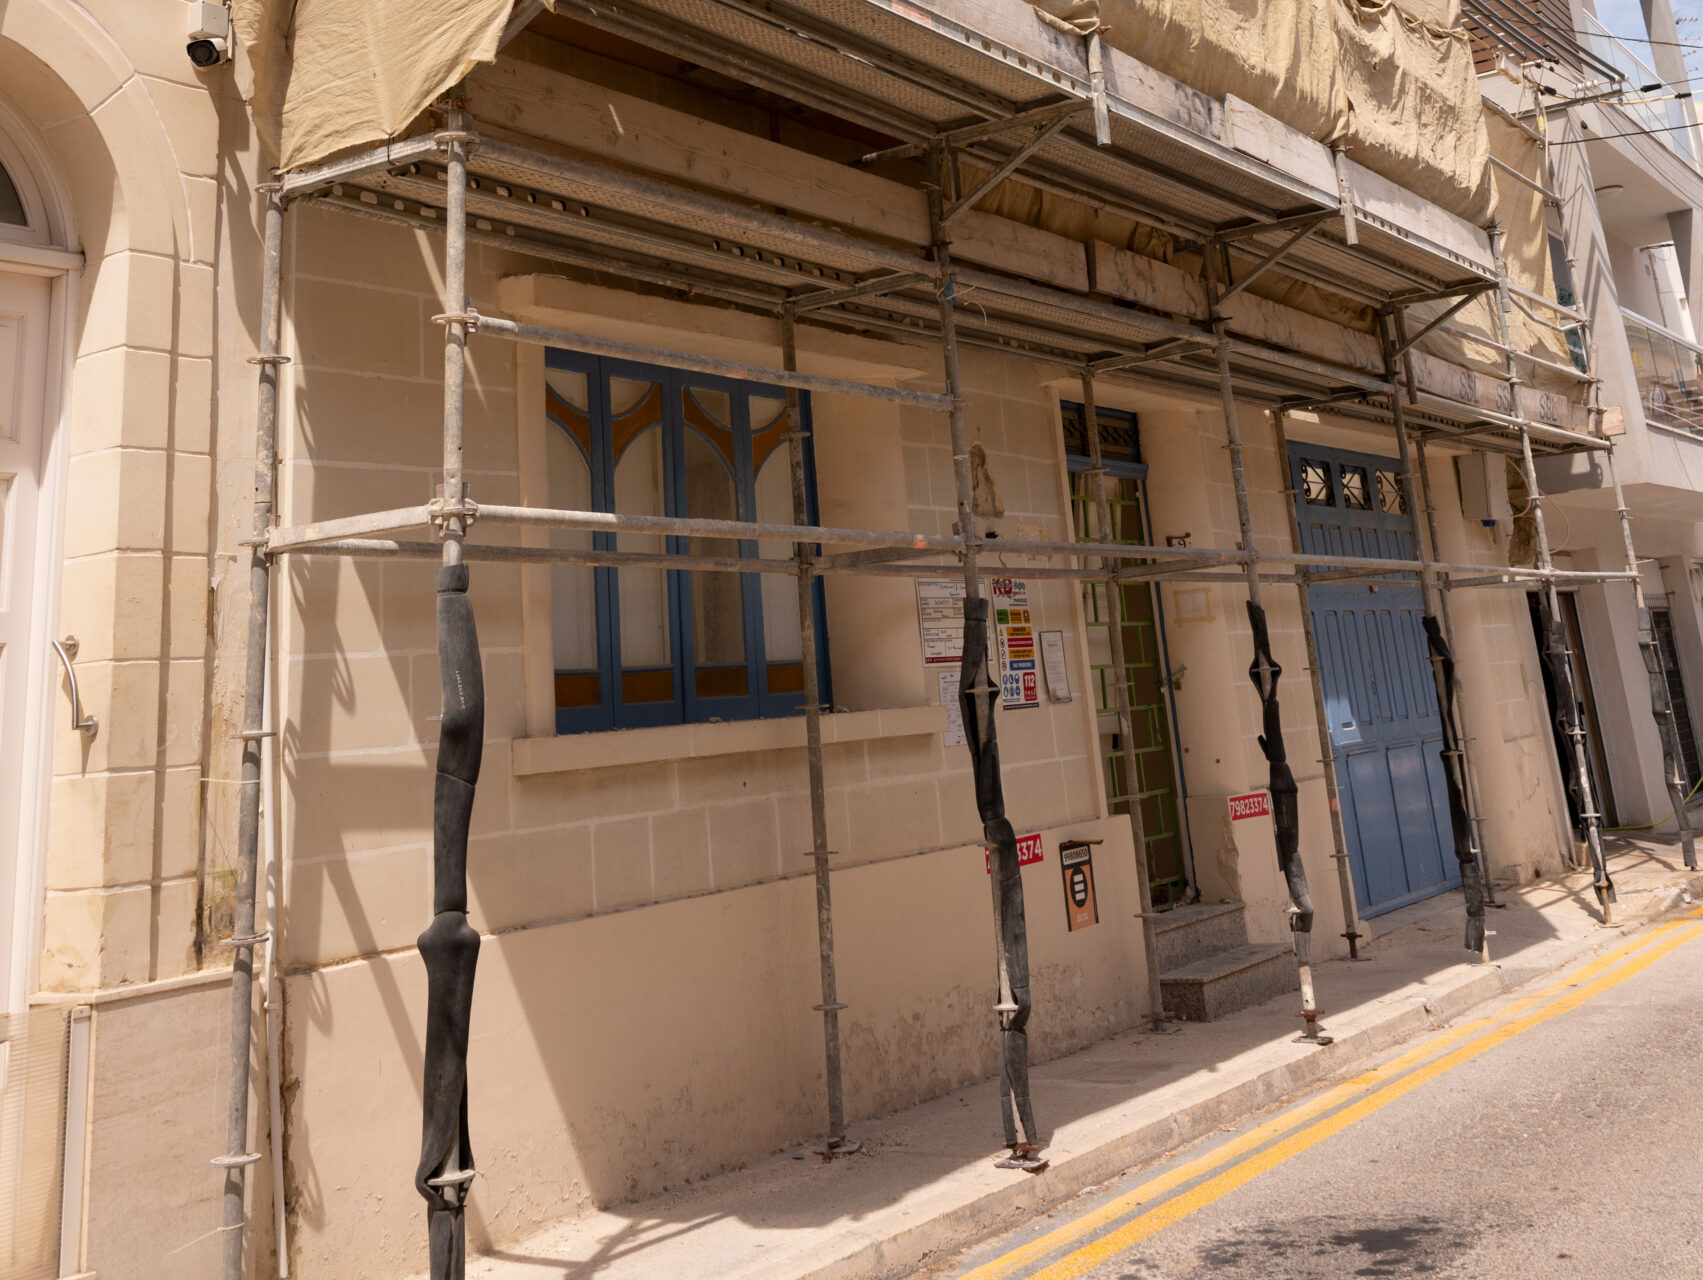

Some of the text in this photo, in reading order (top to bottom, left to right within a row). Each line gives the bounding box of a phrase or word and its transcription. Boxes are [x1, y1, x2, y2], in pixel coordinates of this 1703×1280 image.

[1459, 371, 1479, 403] SSL
[1539, 395, 1557, 422] SSL
[1024, 675, 1035, 688] 112
[1230, 797, 1267, 816] 79823374
